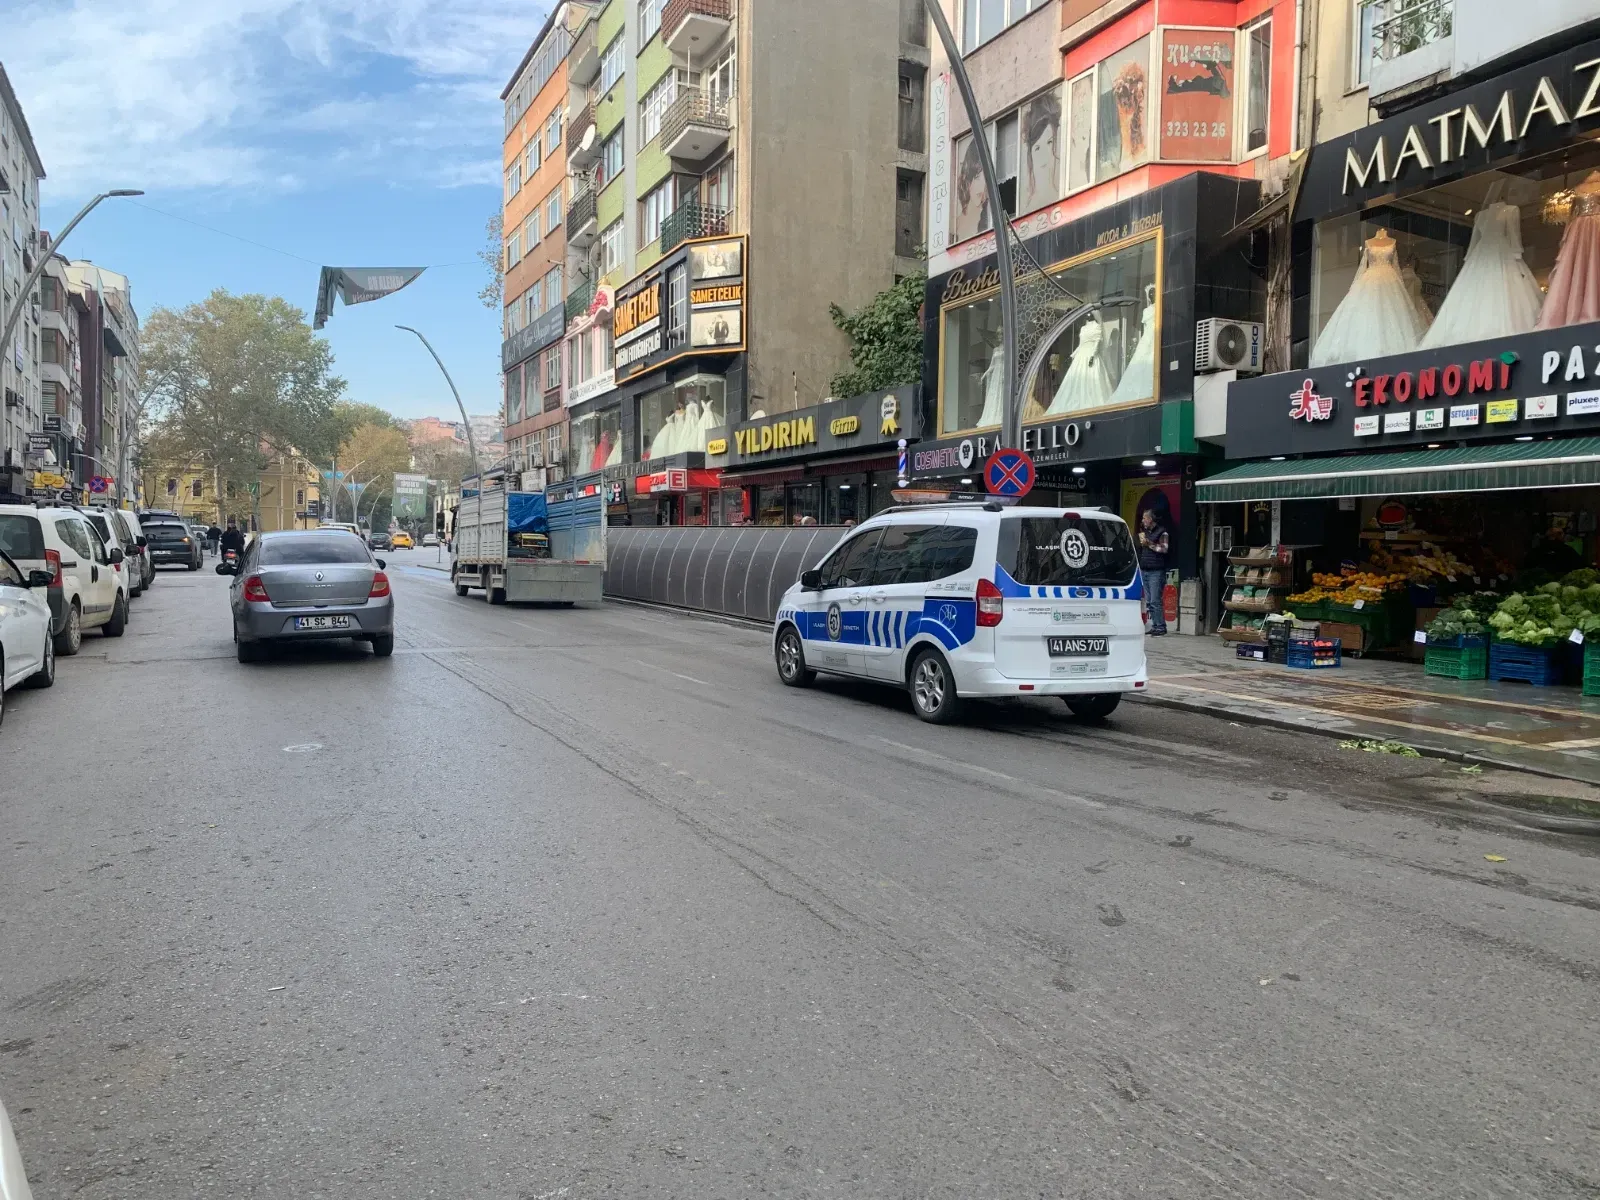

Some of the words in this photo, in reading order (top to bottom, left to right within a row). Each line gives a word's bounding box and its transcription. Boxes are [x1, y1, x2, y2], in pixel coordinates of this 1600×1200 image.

[1167, 121, 1189, 138] 323
[1193, 121, 1208, 138] 23
[1211, 121, 1226, 138] 26
[1035, 206, 1064, 232] 26
[1096, 226, 1120, 247] MODA
[691, 287, 717, 304] SAMET
[615, 297, 639, 337] SAMET
[1251, 325, 1259, 367] BEKO
[1569, 396, 1600, 407] pluxee
[1450, 408, 1478, 420] SETCARD
[1416, 421, 1443, 431] MULTINET
[734, 415, 816, 455] YILDIRIM
[978, 422, 1080, 458] RAELLO
[914, 446, 959, 471] COSMETIC
[671, 472, 684, 487] E
[300, 617, 310, 627] 41
[314, 617, 326, 626] SC
[331, 616, 348, 625] 844
[1053, 640, 1064, 652] 41
[1065, 639, 1087, 652] ANS
[1087, 639, 1106, 652] 707
